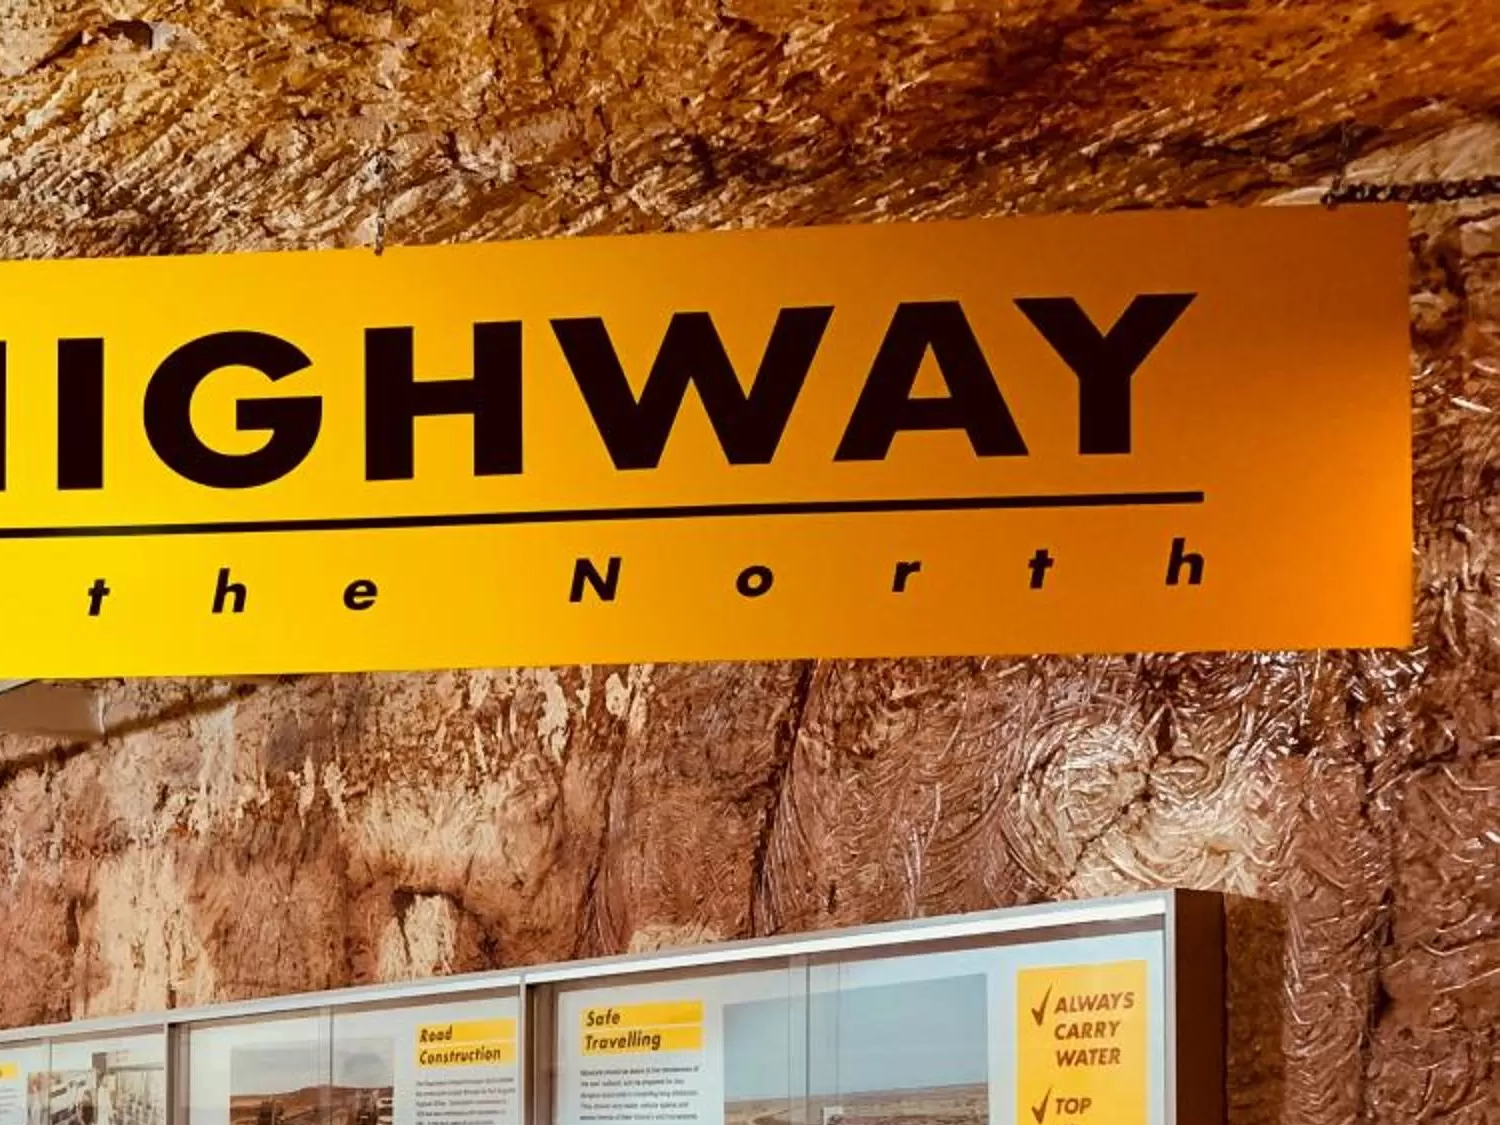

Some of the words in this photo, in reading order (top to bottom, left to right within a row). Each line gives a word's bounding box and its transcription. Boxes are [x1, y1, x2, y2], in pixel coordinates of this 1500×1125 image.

[89, 569, 377, 616] the
[570, 538, 1204, 602] North
[1054, 991, 1135, 1014] ALWAYS
[585, 1008, 621, 1027] Safe
[419, 1025, 453, 1043] Road
[1054, 1020, 1121, 1040] CARRY
[585, 1031, 662, 1050] Travelling
[419, 1046, 501, 1065] Construction
[1056, 1047, 1121, 1067] WATER
[1055, 1097, 1092, 1115] TOP
